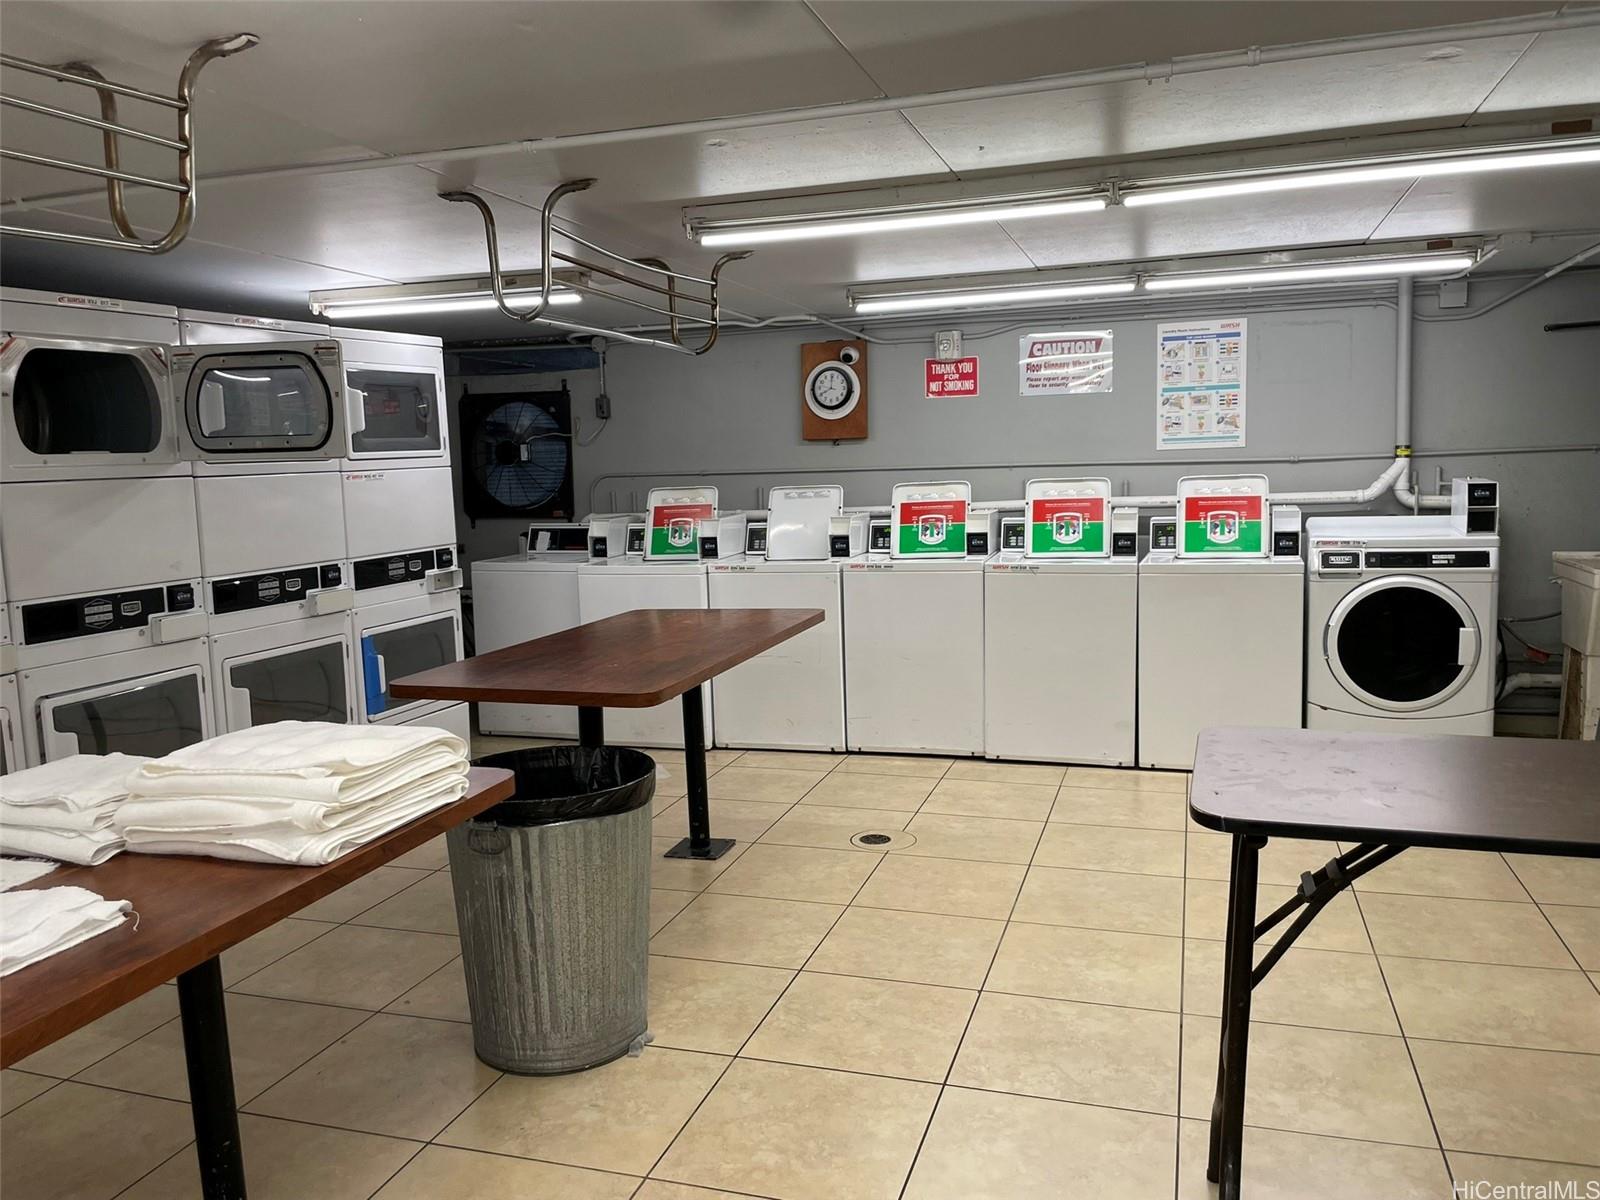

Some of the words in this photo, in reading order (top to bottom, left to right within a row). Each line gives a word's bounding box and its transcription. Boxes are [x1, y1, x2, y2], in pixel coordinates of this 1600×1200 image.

[1032, 341, 1096, 356] CAUTION
[931, 363, 957, 375] THANK
[957, 362, 973, 374] YOU
[1026, 362, 1042, 373] Floor
[1043, 375, 1059, 383] report
[930, 381, 943, 392] NOT
[943, 380, 975, 392] SMOKING
